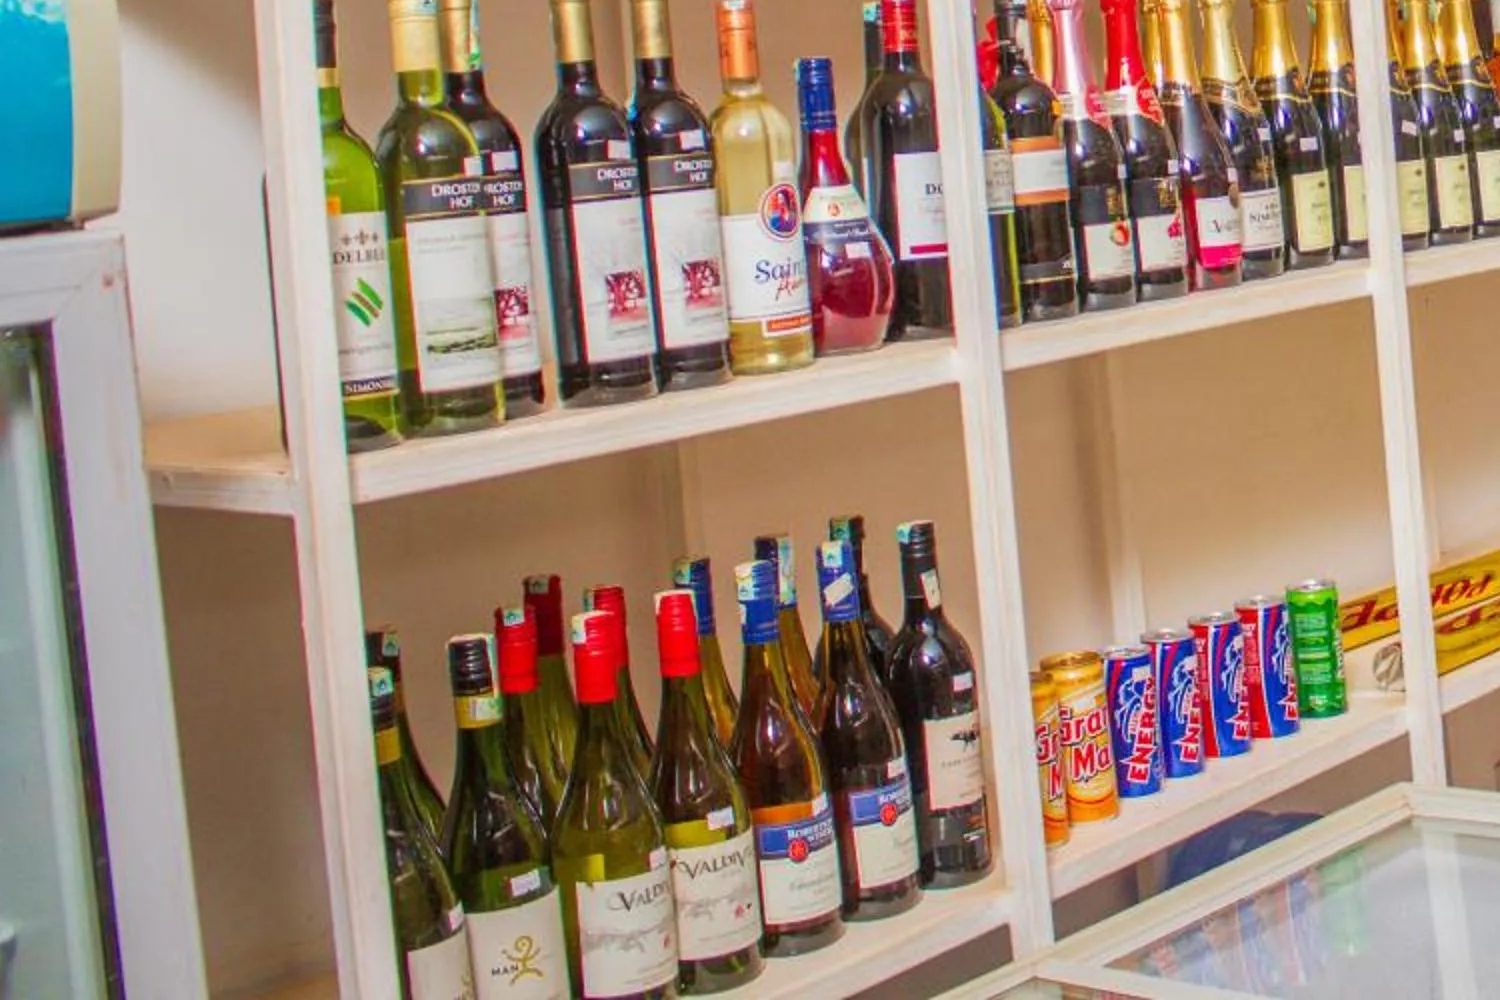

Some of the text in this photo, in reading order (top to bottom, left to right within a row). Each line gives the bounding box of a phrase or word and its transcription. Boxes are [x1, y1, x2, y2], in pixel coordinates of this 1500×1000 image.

[449, 194, 474, 210] HOF
[492, 193, 516, 207] HOF
[754, 257, 804, 285] Sain
[1070, 741, 1113, 783] Ma
[490, 963, 520, 978] MAN
